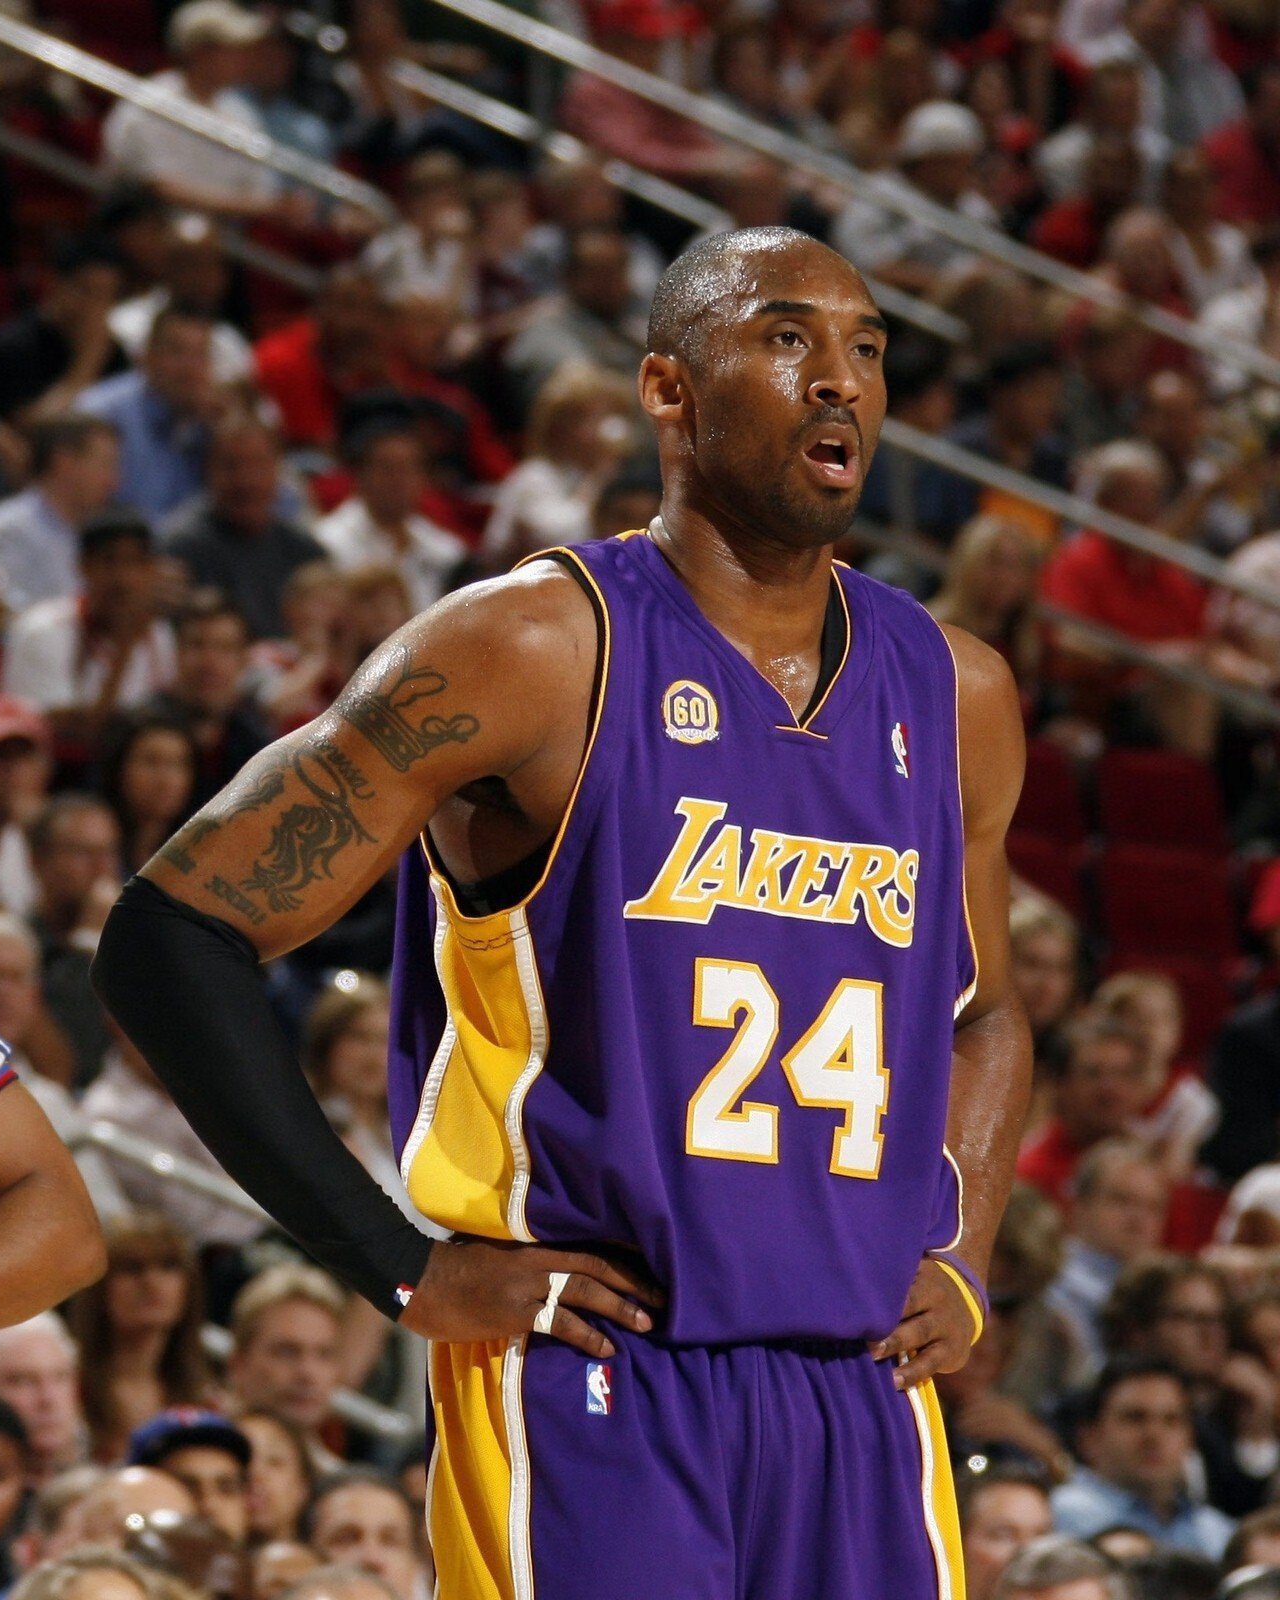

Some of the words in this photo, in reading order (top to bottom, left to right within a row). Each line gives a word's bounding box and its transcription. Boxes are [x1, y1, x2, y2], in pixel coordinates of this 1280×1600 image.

[673, 695, 706, 727] 60
[623, 796, 919, 948] LAKERS
[685, 956, 891, 1181] 24
[588, 1403, 604, 1412] NBA
